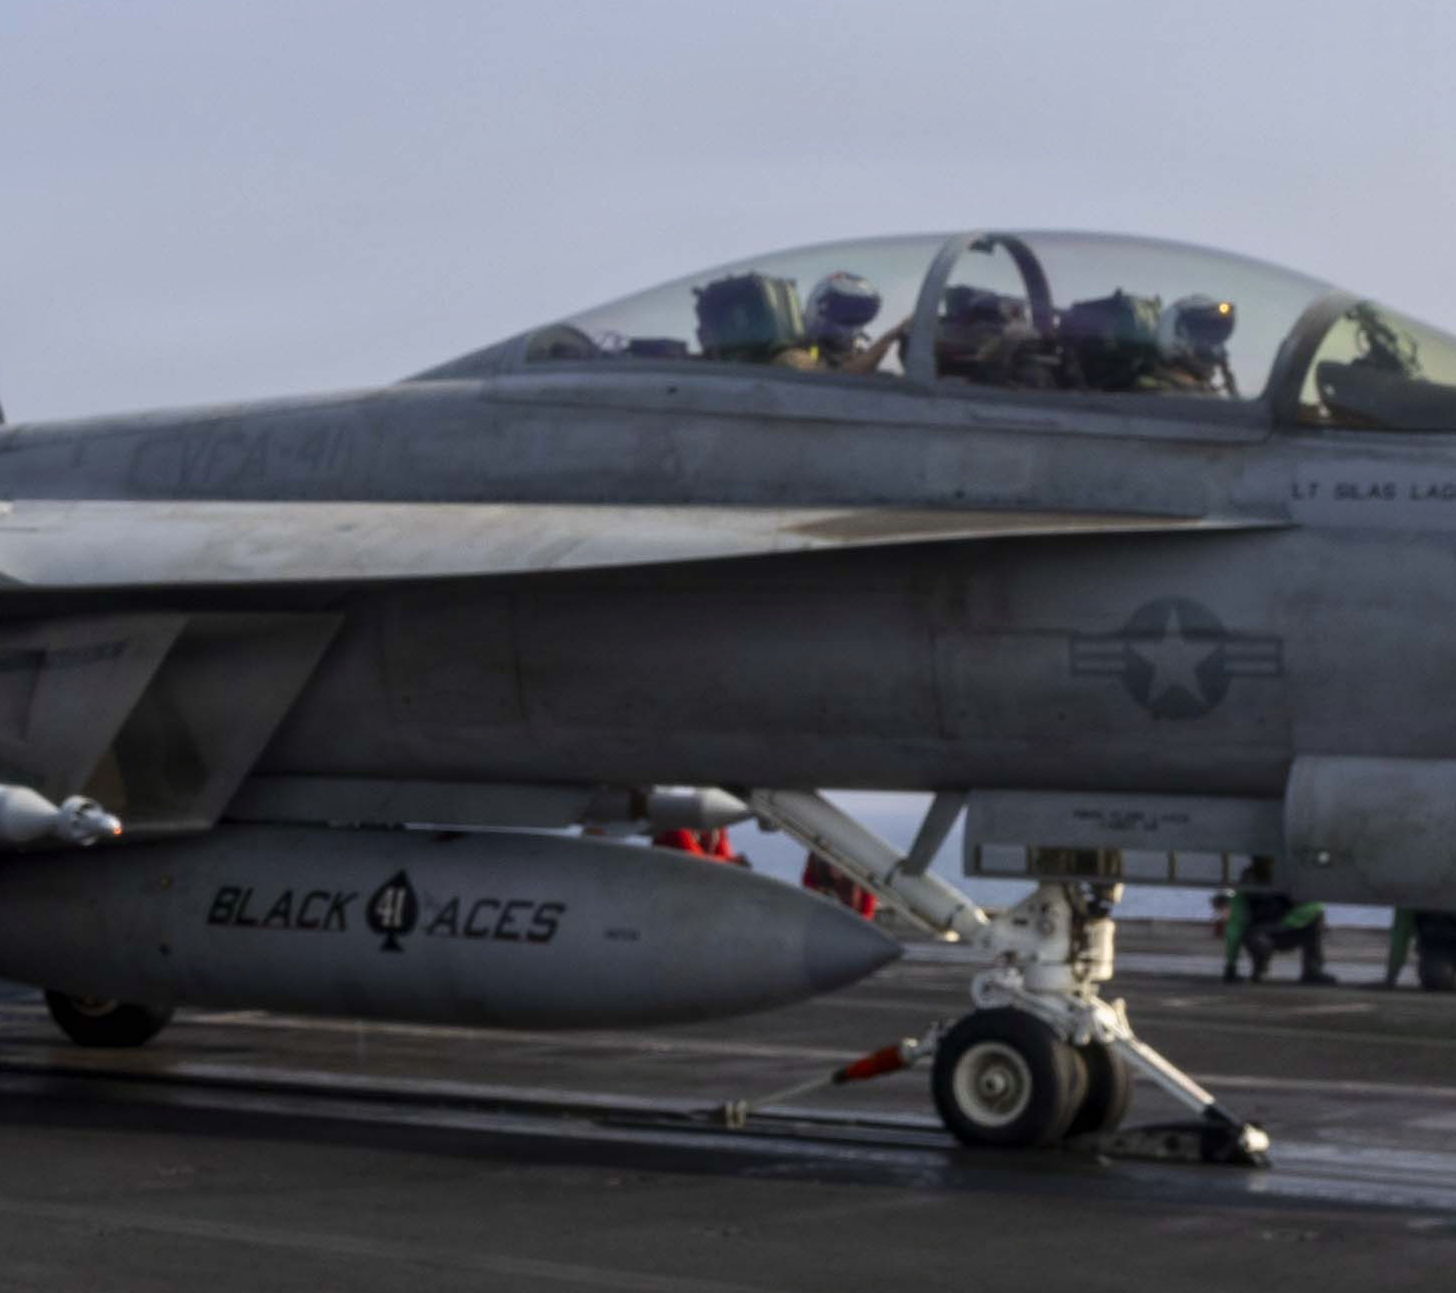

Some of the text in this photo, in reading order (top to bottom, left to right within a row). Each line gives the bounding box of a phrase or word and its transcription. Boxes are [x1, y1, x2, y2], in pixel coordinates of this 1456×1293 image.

[206, 884, 567, 944] BLACK 41 ACES
